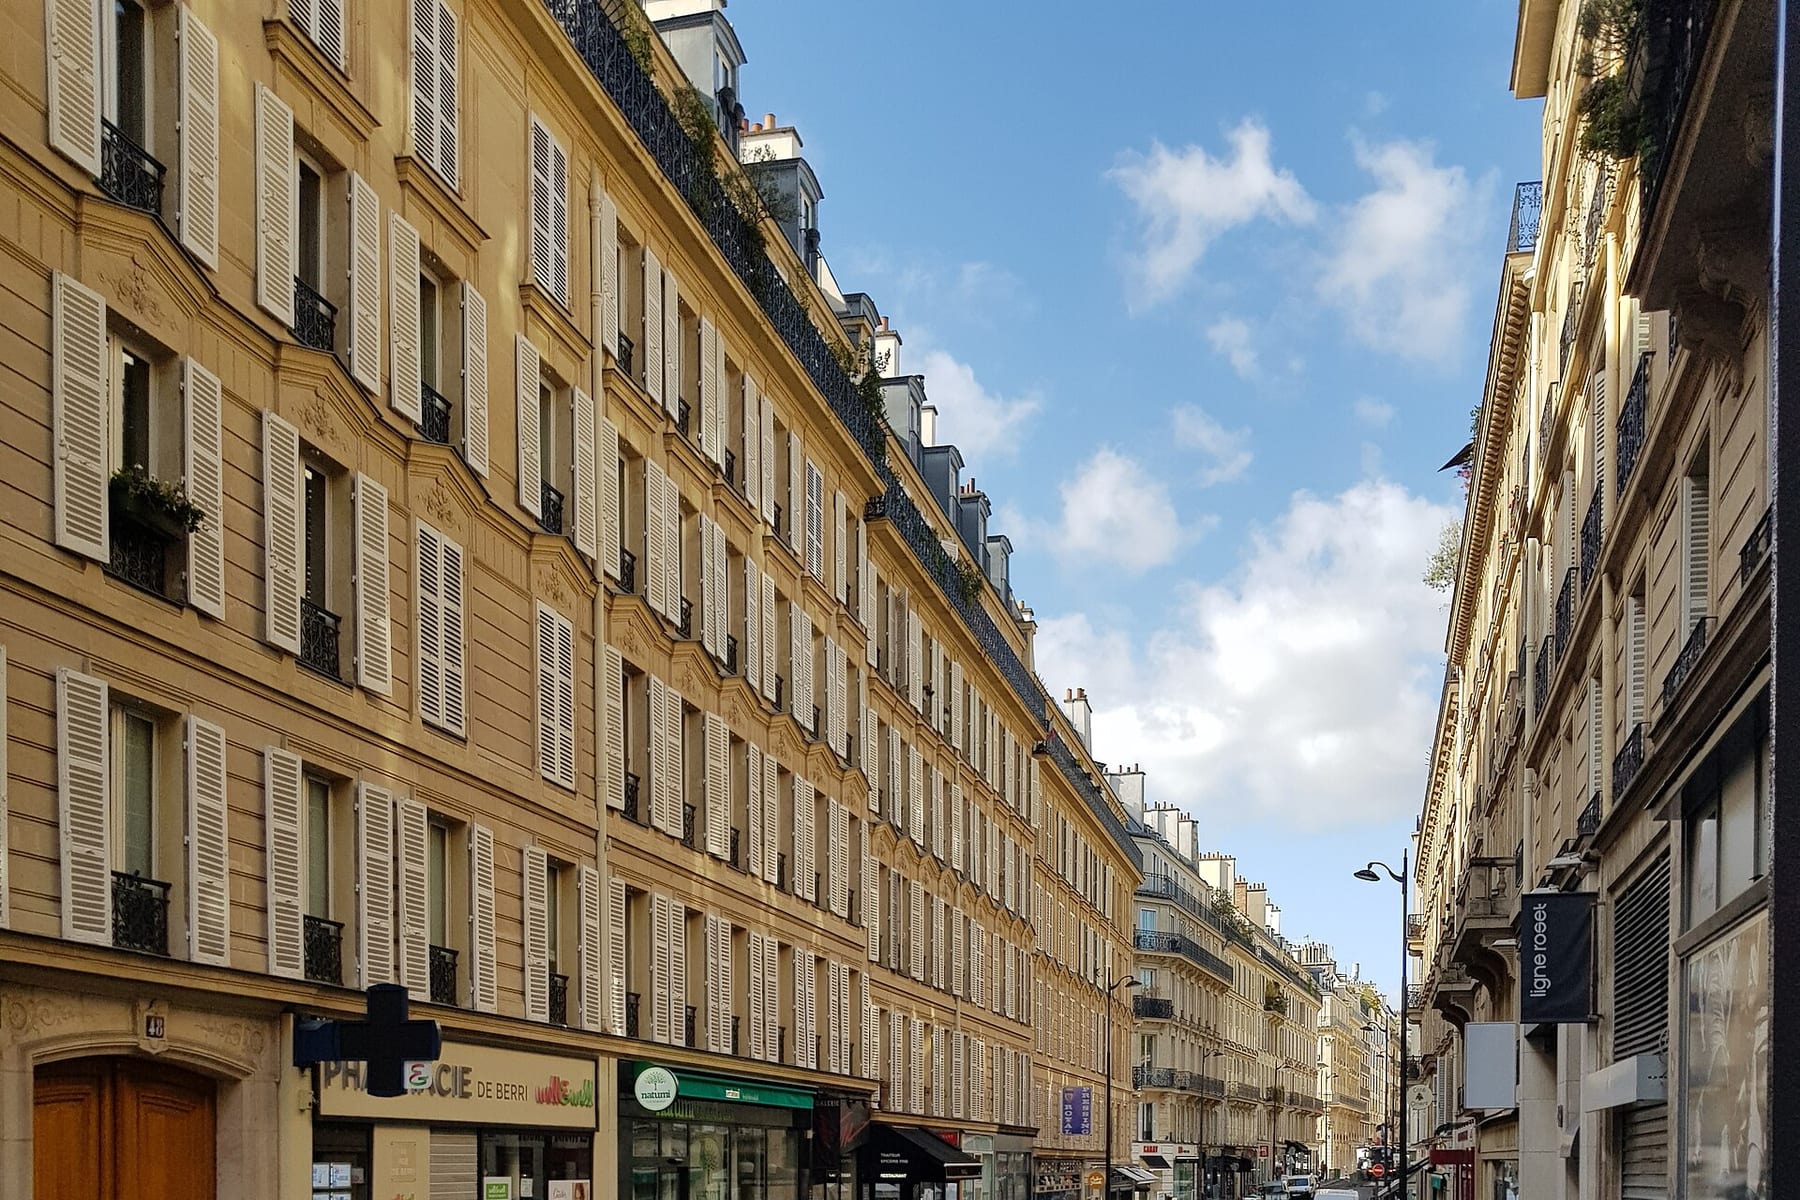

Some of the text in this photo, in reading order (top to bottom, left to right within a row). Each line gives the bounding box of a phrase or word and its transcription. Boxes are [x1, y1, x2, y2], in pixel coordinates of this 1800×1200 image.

[1529, 953, 1551, 997] ligne
[148, 1017, 164, 1036] 48
[477, 1081, 492, 1099] DE
[496, 1082, 528, 1101] BERRI
[1081, 1087, 1091, 1135] PRESSING
